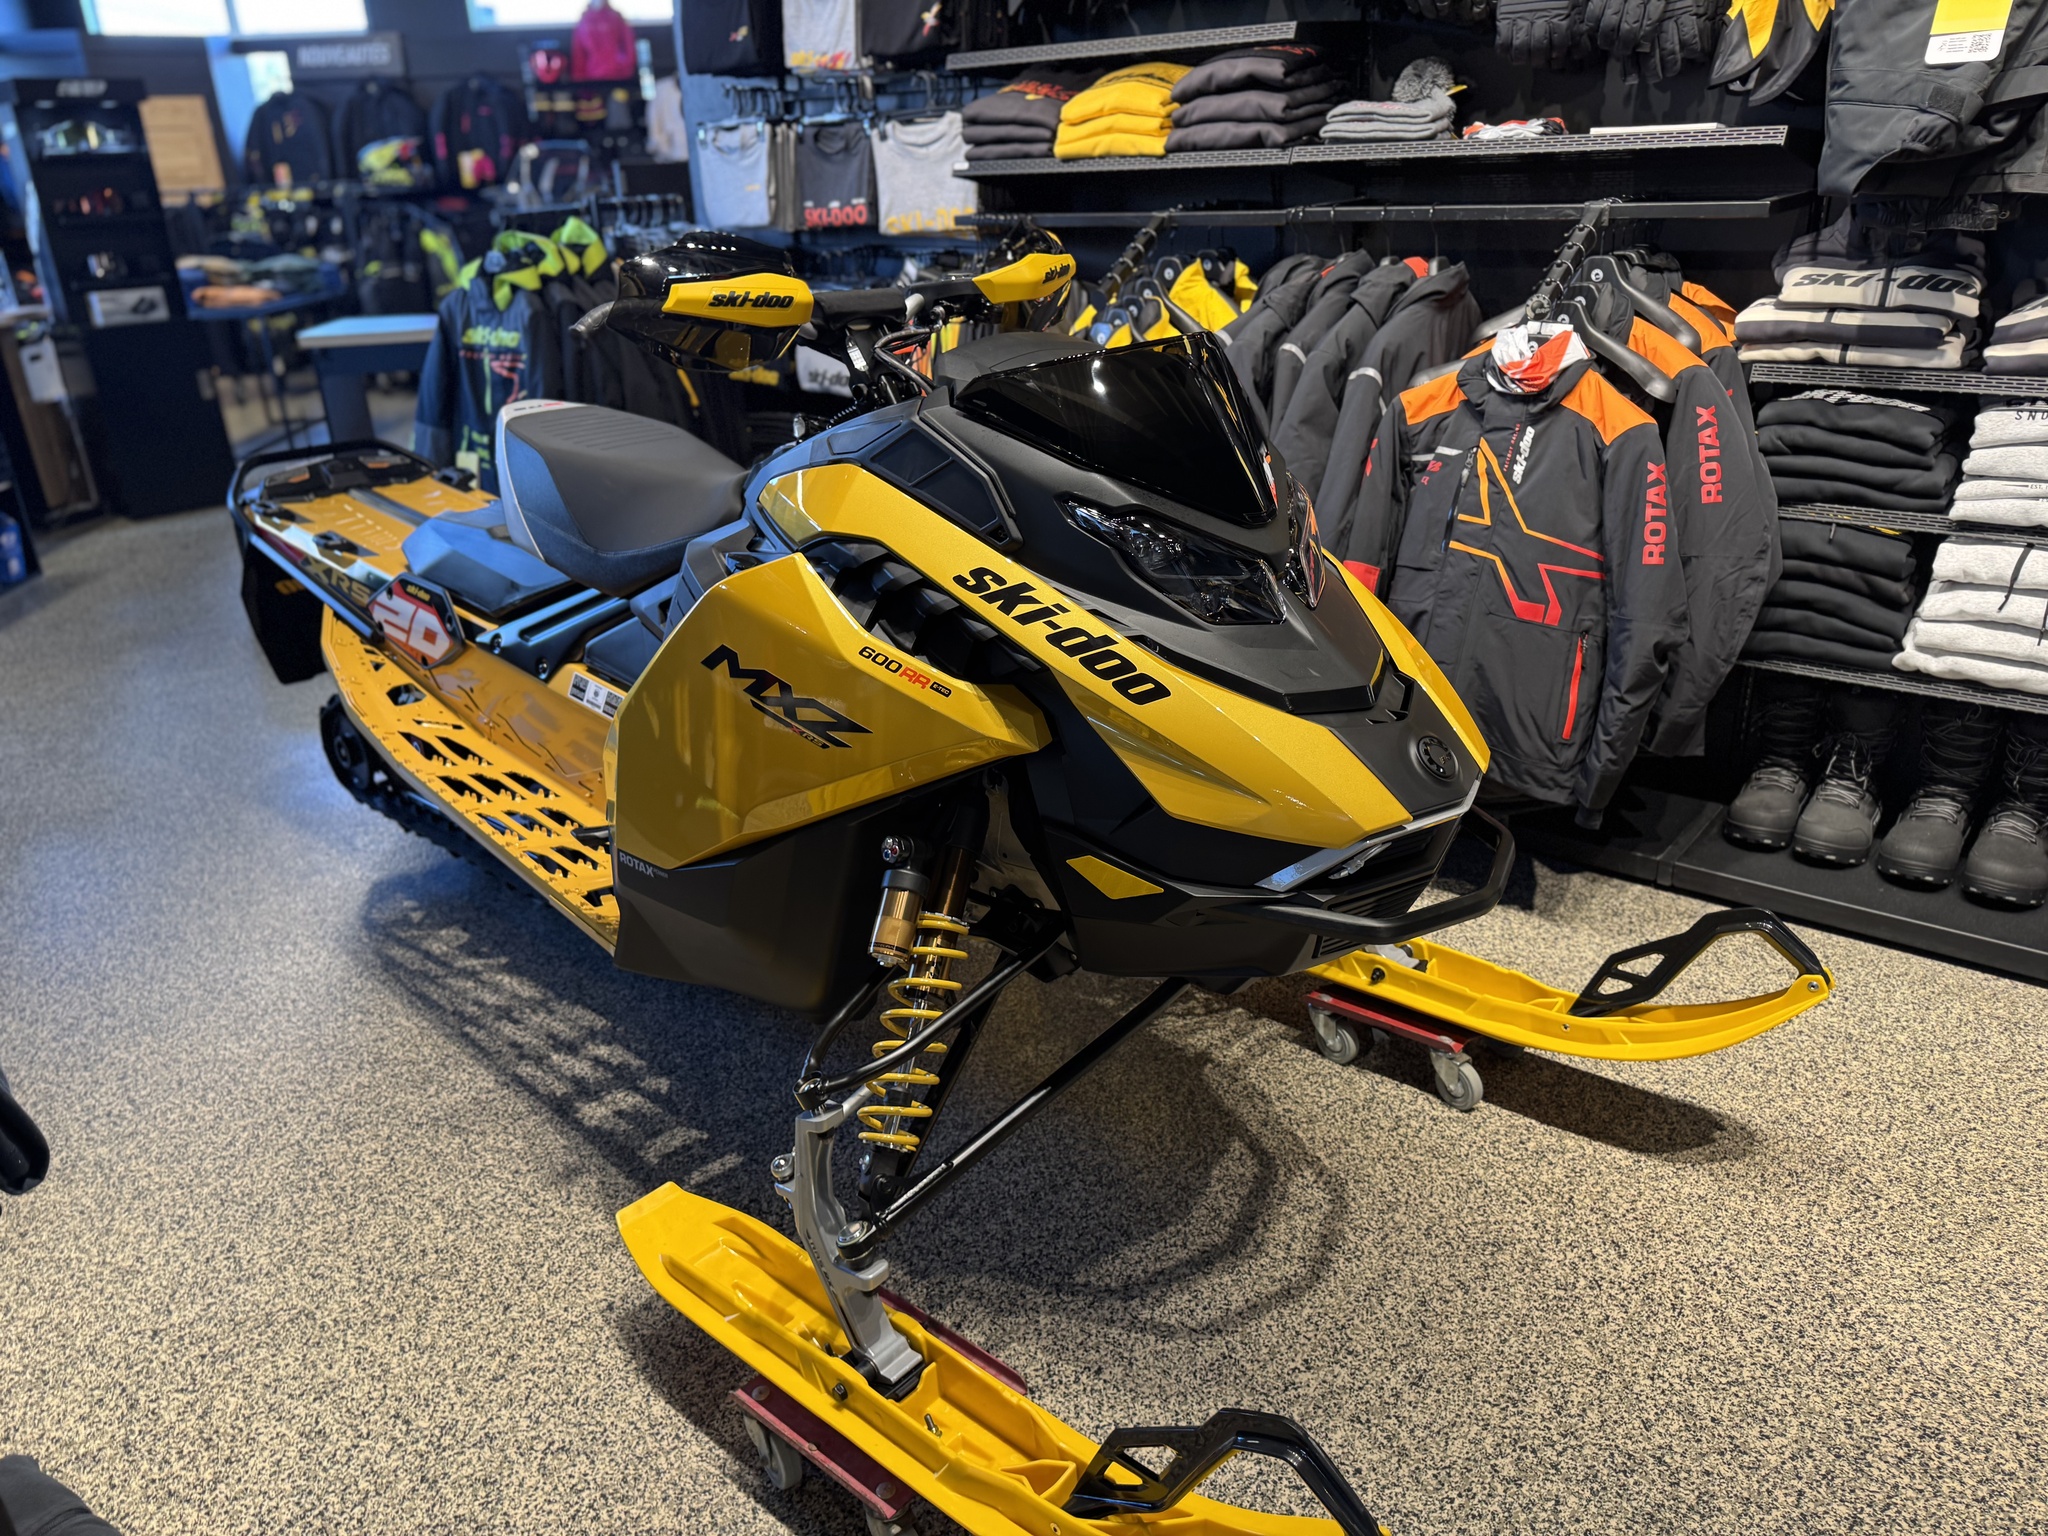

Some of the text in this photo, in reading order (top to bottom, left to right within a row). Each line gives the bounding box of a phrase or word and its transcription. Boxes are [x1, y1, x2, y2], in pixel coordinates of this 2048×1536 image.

[804, 205, 868, 228] SKI-DOO
[708, 291, 795, 309] ski-doo
[1042, 263, 1071, 284] ski-doo
[1512, 425, 1536, 485] ski-doo
[1695, 405, 1723, 504] ROTAX
[1642, 461, 1667, 565] ROTAX
[371, 594, 451, 661] 20
[952, 566, 1172, 706] ski-doo
[700, 643, 873, 748] MXZ
[619, 851, 655, 878] ROTAX
